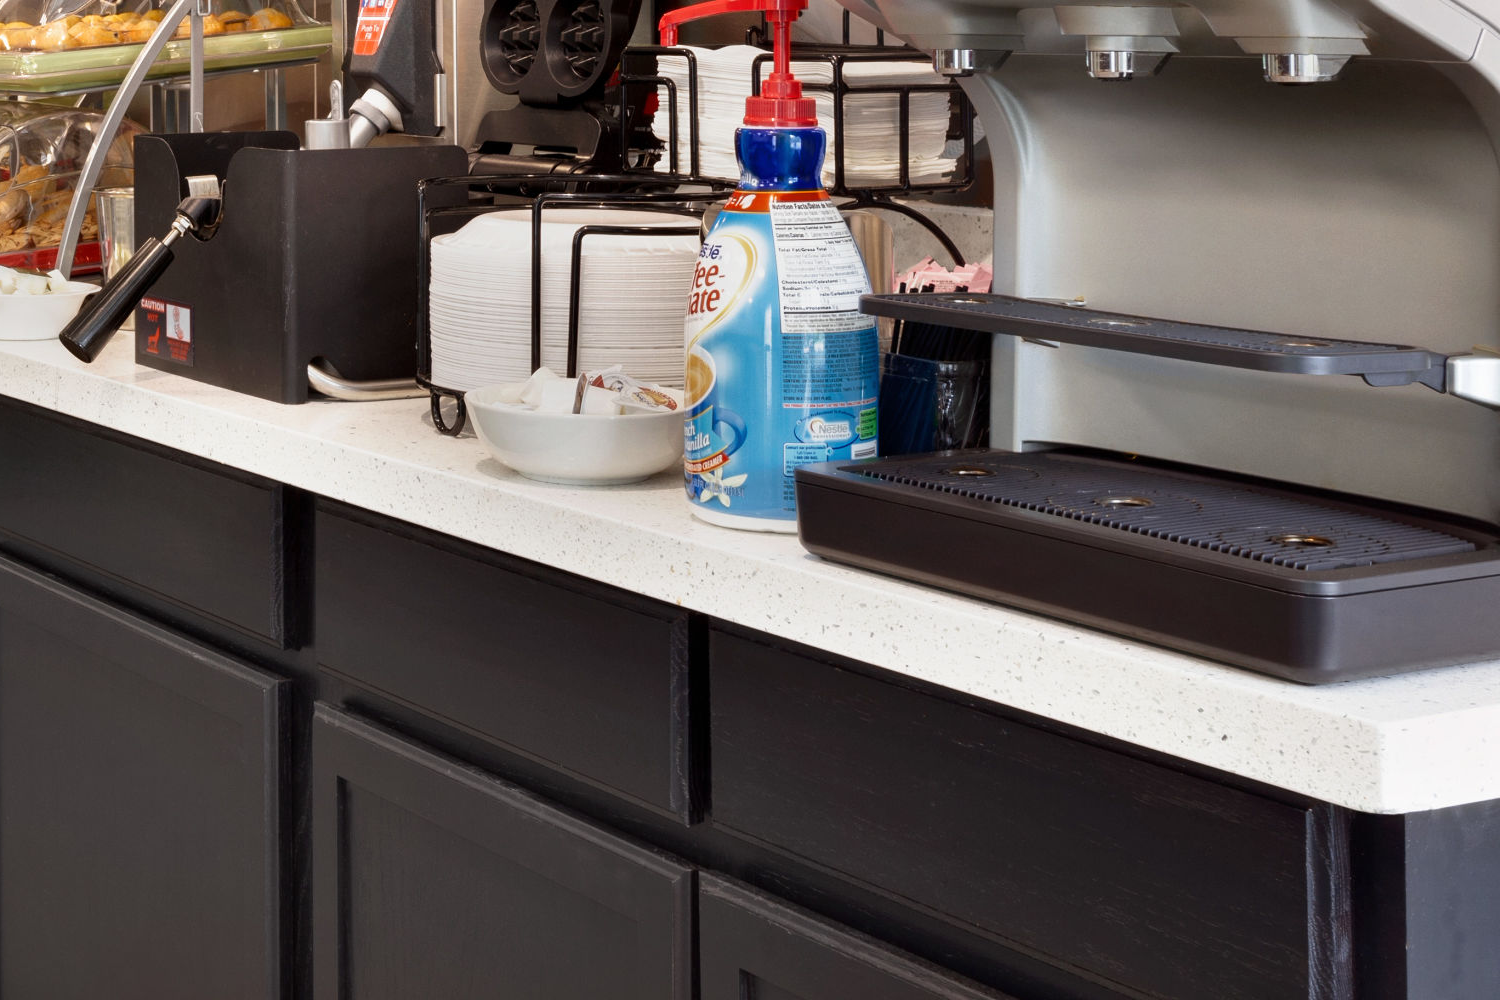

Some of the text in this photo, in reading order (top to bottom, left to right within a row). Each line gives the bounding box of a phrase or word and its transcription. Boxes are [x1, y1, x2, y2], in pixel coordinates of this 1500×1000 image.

[374, 24, 379, 32] To
[141, 298, 164, 313] CAUTION
[147, 312, 159, 323] HOT
